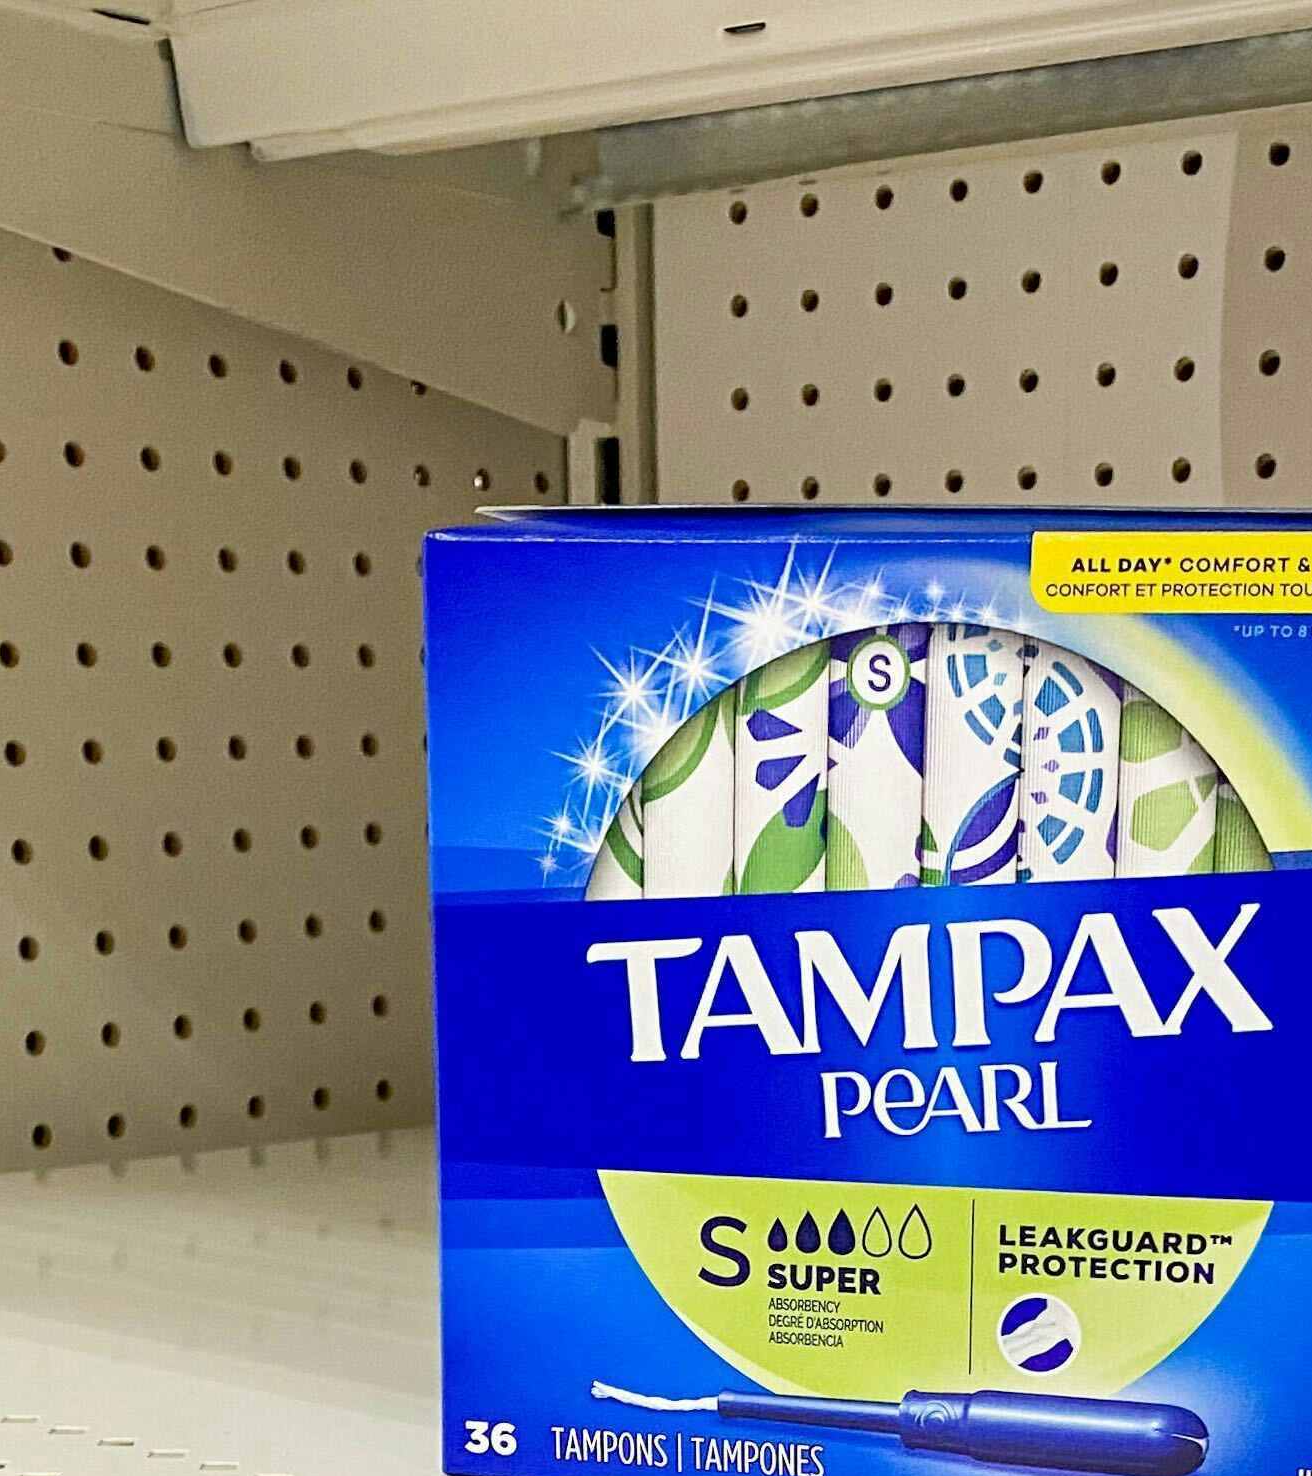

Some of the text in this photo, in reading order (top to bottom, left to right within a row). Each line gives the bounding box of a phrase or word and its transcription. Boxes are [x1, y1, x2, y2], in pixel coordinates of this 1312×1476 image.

[1071, 557, 1111, 573] ALL
[1179, 557, 1290, 573] COMFORT
[1298, 557, 1311, 573] &
[1045, 582, 1131, 597] CONFORT
[1136, 582, 1157, 597] ET
[1161, 582, 1275, 597] PROTECTION
[1270, 624, 1294, 638] TO
[1297, 624, 1308, 638] 8
[868, 654, 892, 692] S
[586, 903, 1274, 1062] TAMPAX
[698, 1216, 751, 1287] S
[767, 1263, 882, 1295] SUPER
[998, 1252, 1215, 1285] PROTECTION
[768, 1298, 841, 1314] ABSORBENCY
[768, 1313, 884, 1334] DEGRÉ D'ABSORPTION
[768, 1331, 844, 1348] ABSORBENCIA
[464, 1420, 518, 1457] 36
[550, 1426, 668, 1468] TAMPONS
